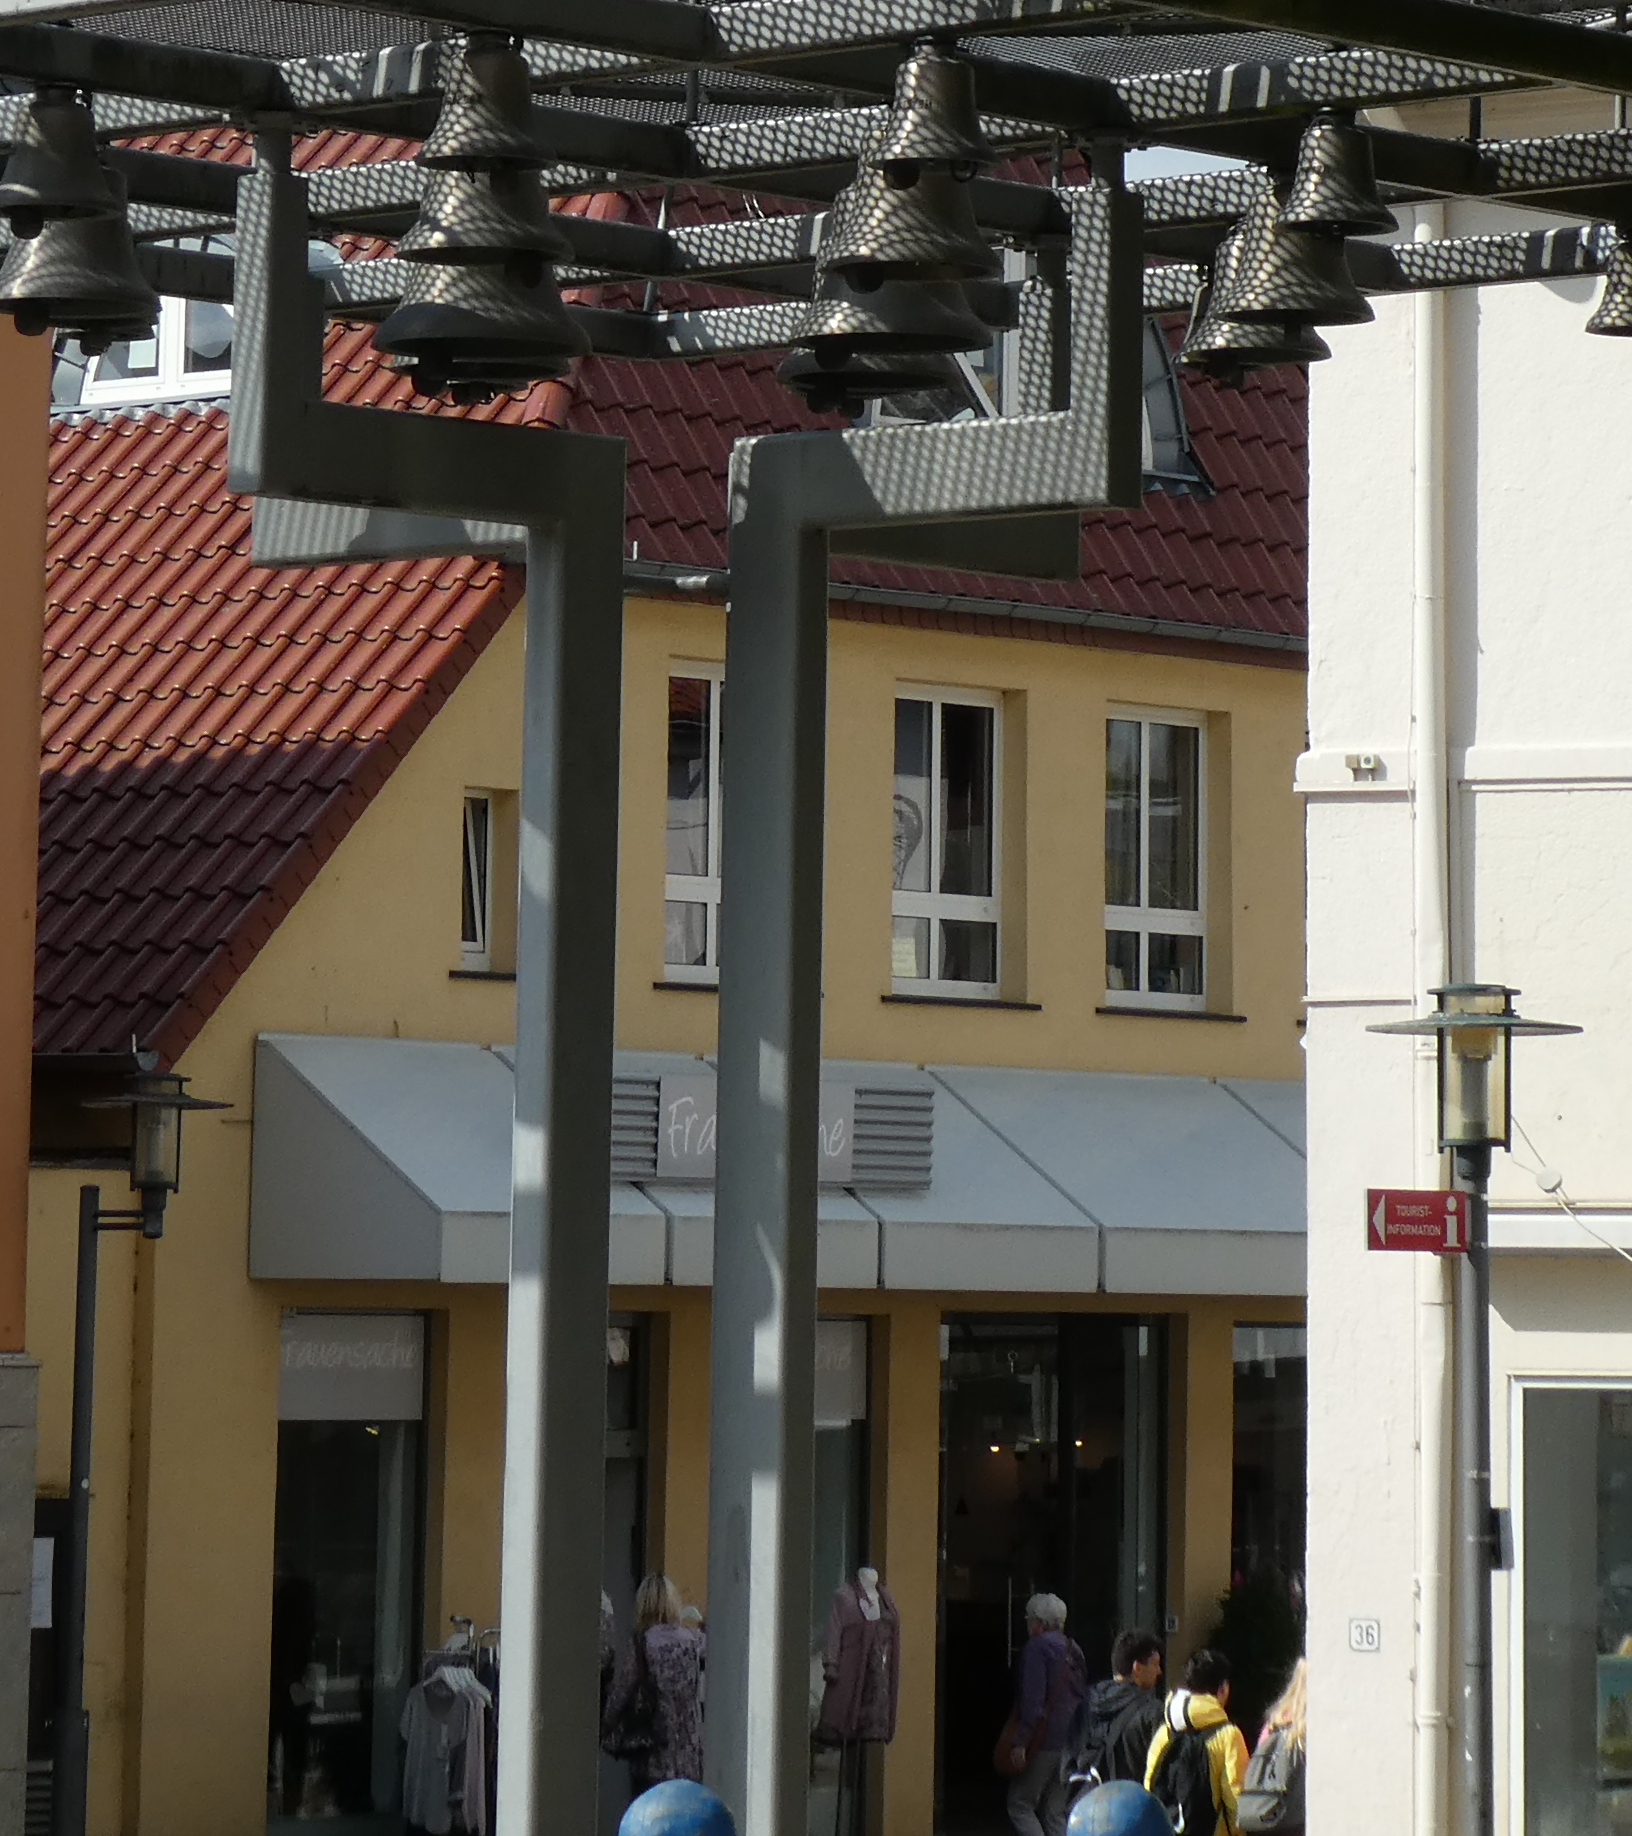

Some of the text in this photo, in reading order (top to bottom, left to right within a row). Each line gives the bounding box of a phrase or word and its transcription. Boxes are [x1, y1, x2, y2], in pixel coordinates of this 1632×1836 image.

[1395, 1205, 1432, 1217] TOURIST-
[1387, 1223, 1442, 1236] INFORMATION
[1354, 1624, 1375, 1645] 36
